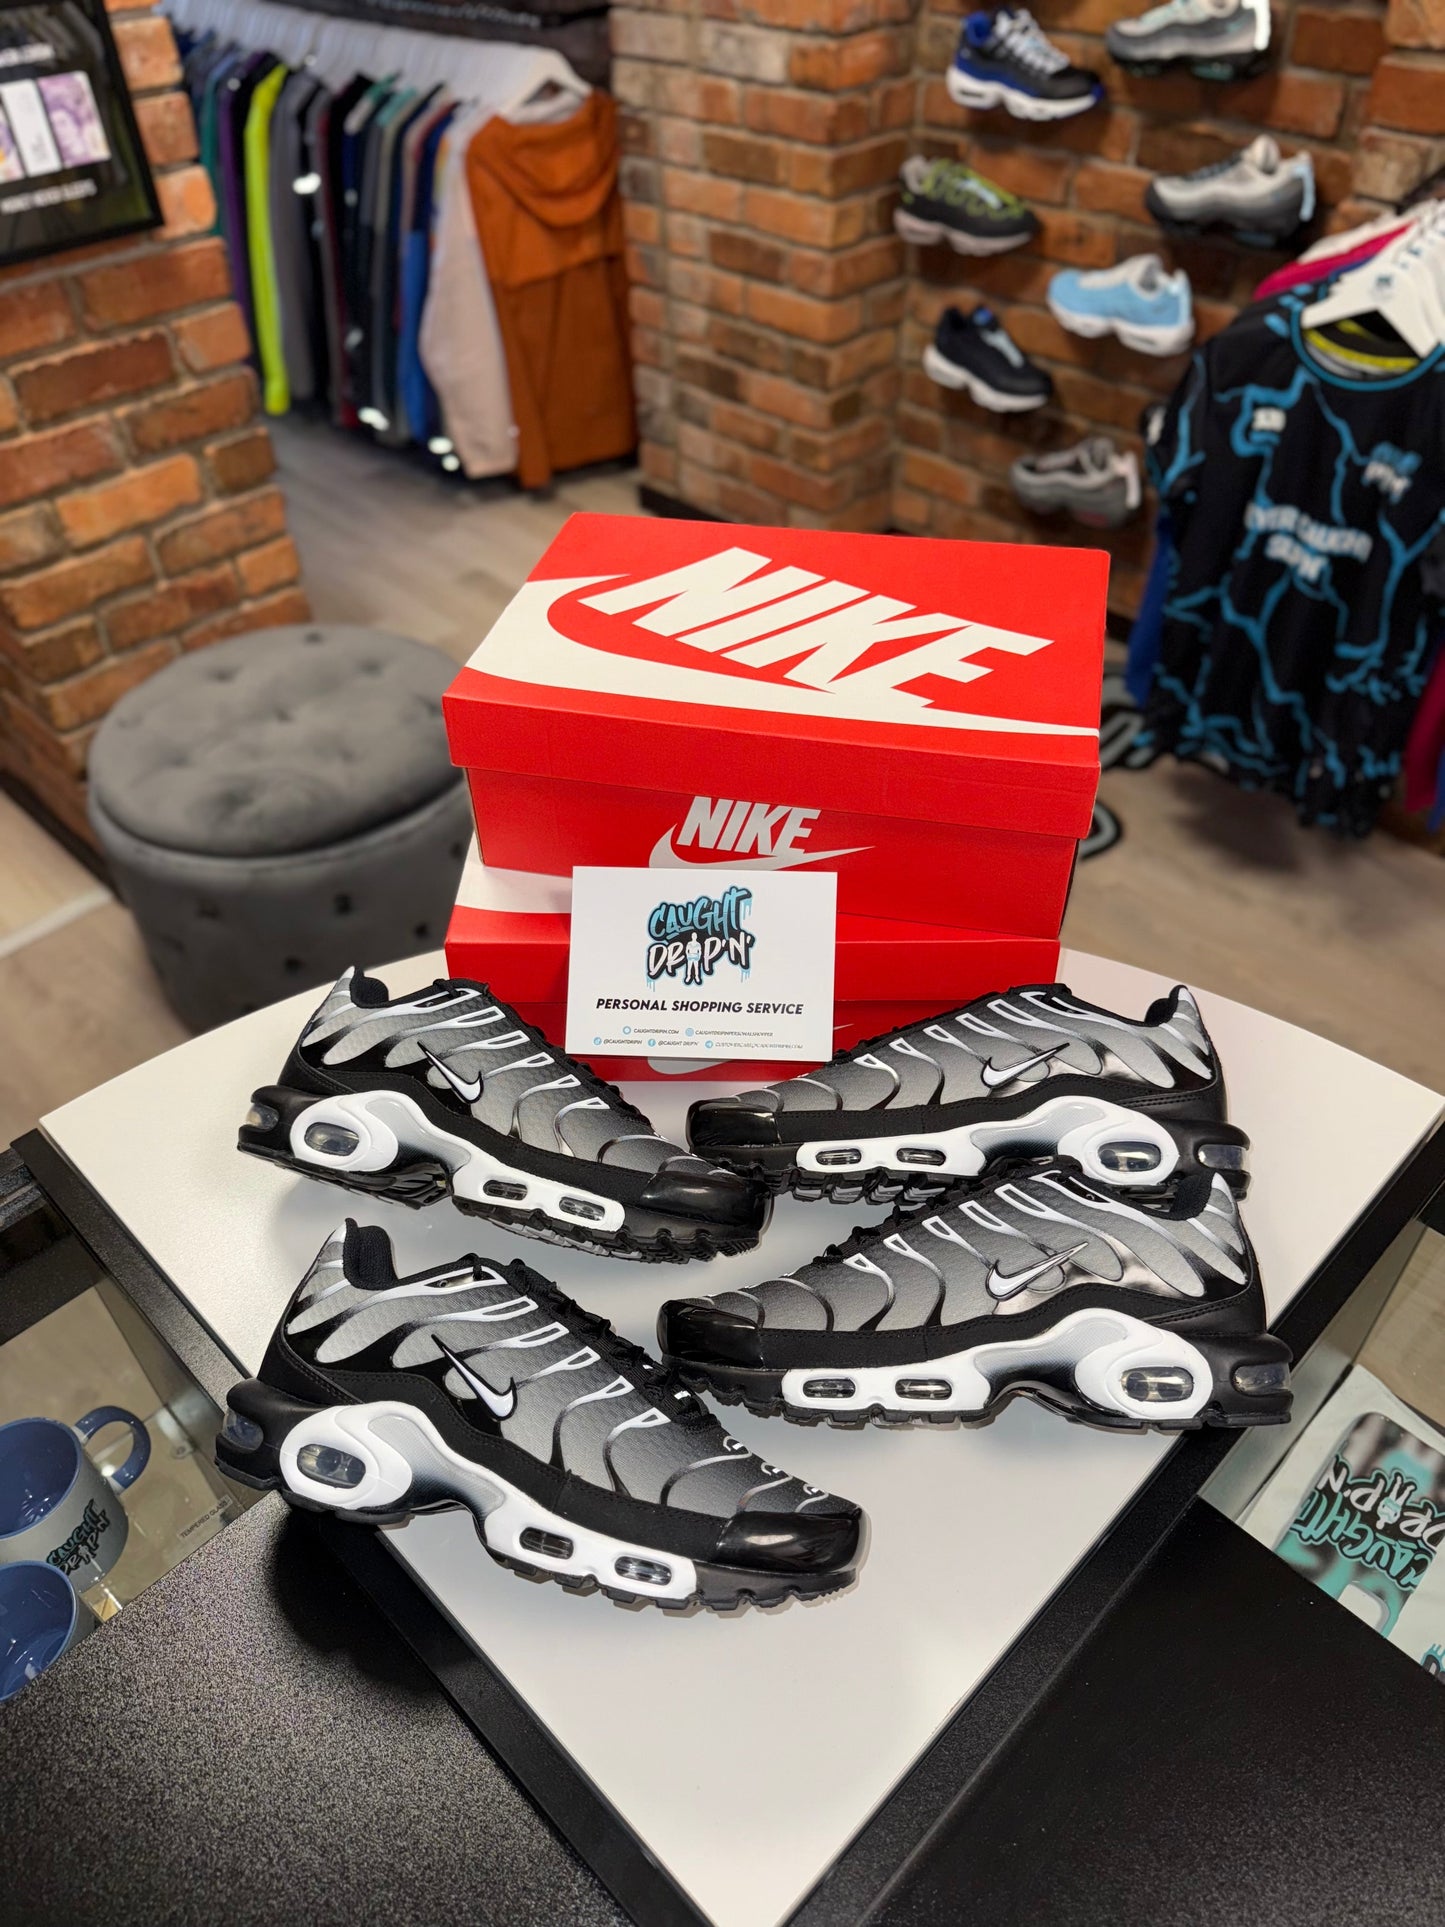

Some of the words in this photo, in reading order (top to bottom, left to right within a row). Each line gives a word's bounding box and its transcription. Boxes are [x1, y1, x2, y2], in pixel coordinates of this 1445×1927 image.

[577, 546, 1054, 708] NIKE
[676, 796, 821, 855] NIKE
[649, 886, 752, 940] CAUGHT
[596, 998, 668, 1011] PERSONAL
[671, 1000, 743, 1013] SHOPPING
[746, 1002, 804, 1015] SERVICE
[180, 1512, 210, 1538] TEMPERED
[209, 1499, 228, 1517] GLASS
